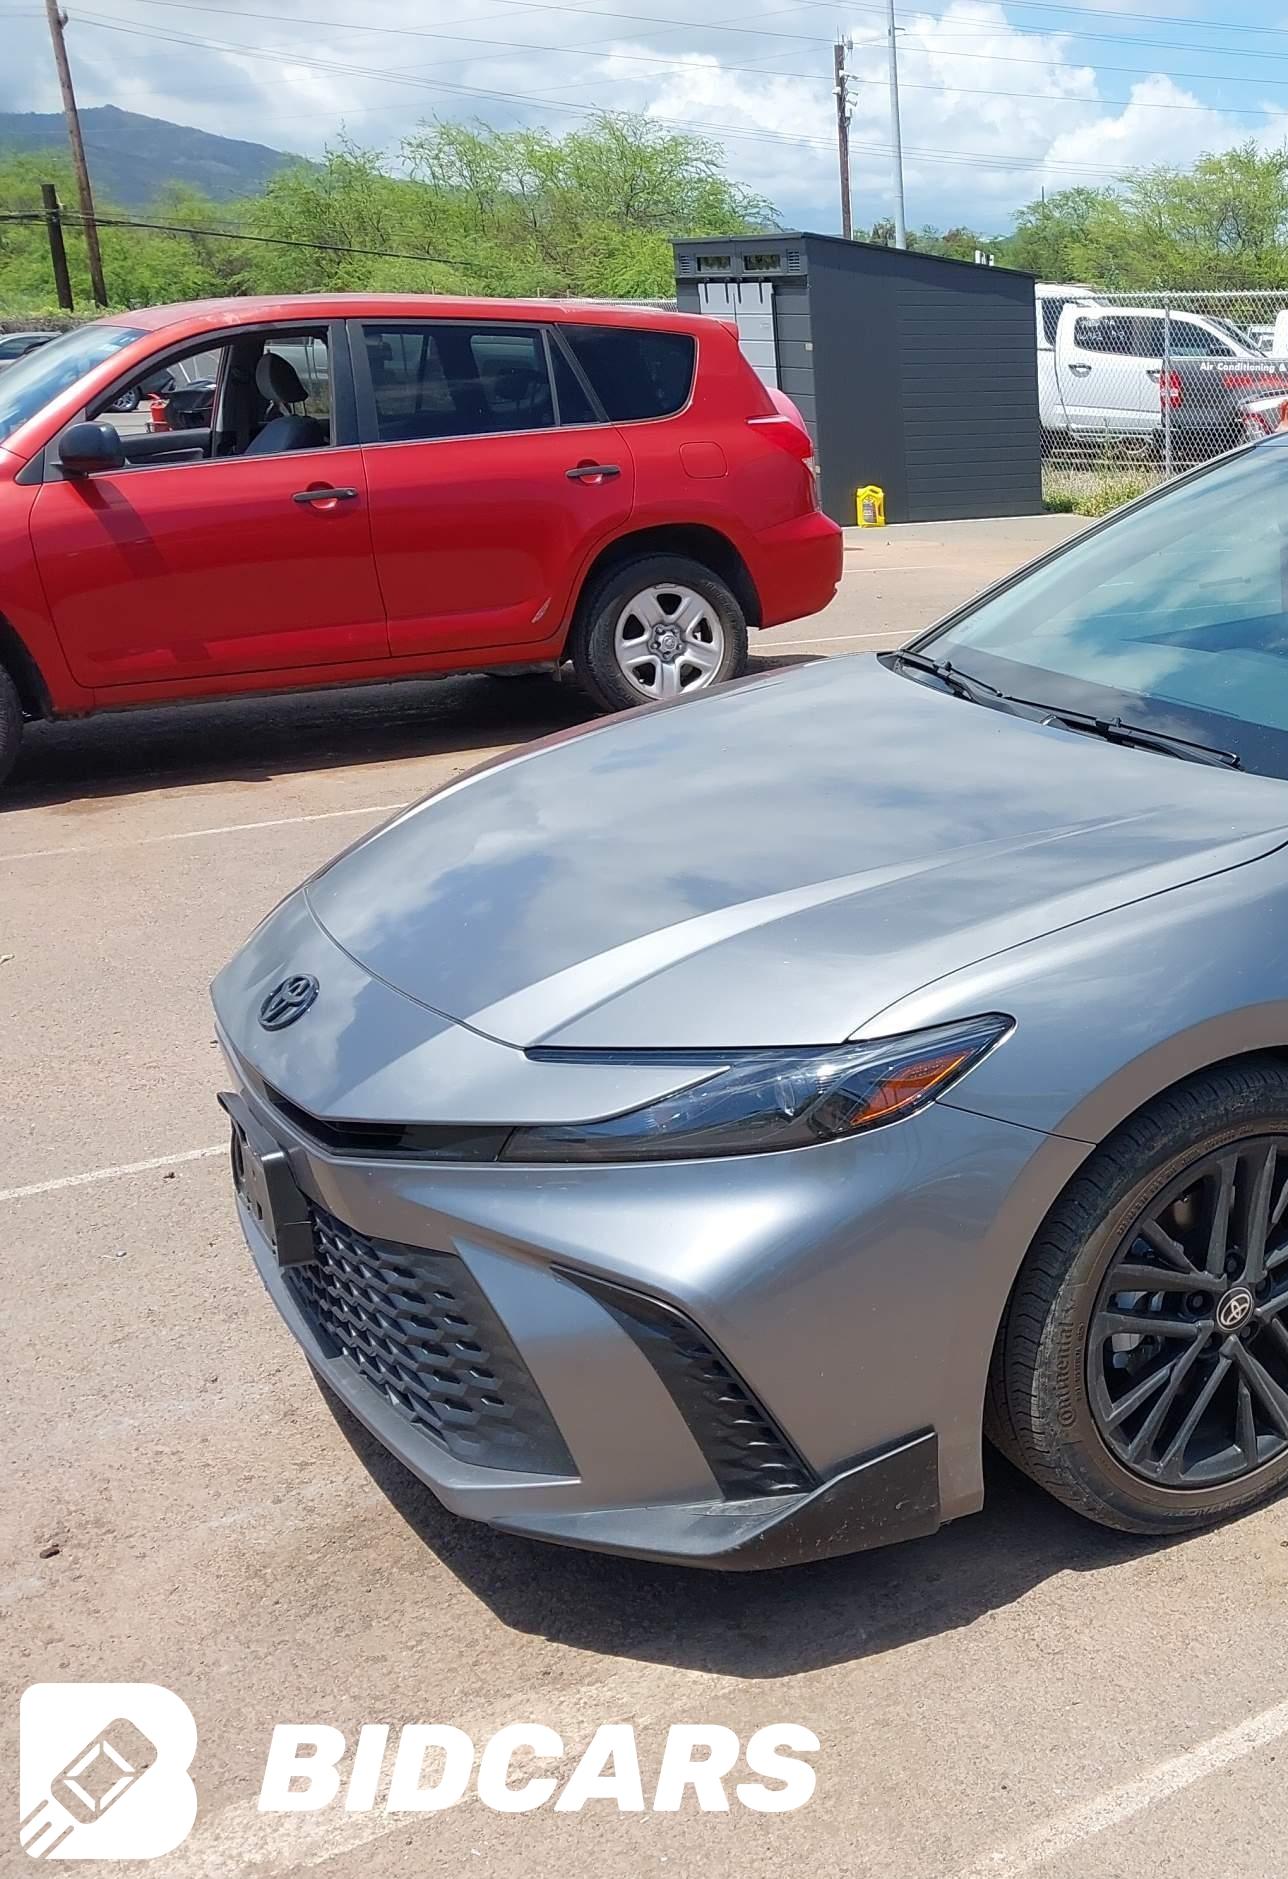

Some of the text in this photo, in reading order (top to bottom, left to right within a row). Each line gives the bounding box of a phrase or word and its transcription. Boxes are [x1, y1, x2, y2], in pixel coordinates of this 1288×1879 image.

[1200, 362, 1214, 371] Air
[1216, 362, 1275, 374] Conditioning
[1279, 363, 1287, 372] &
